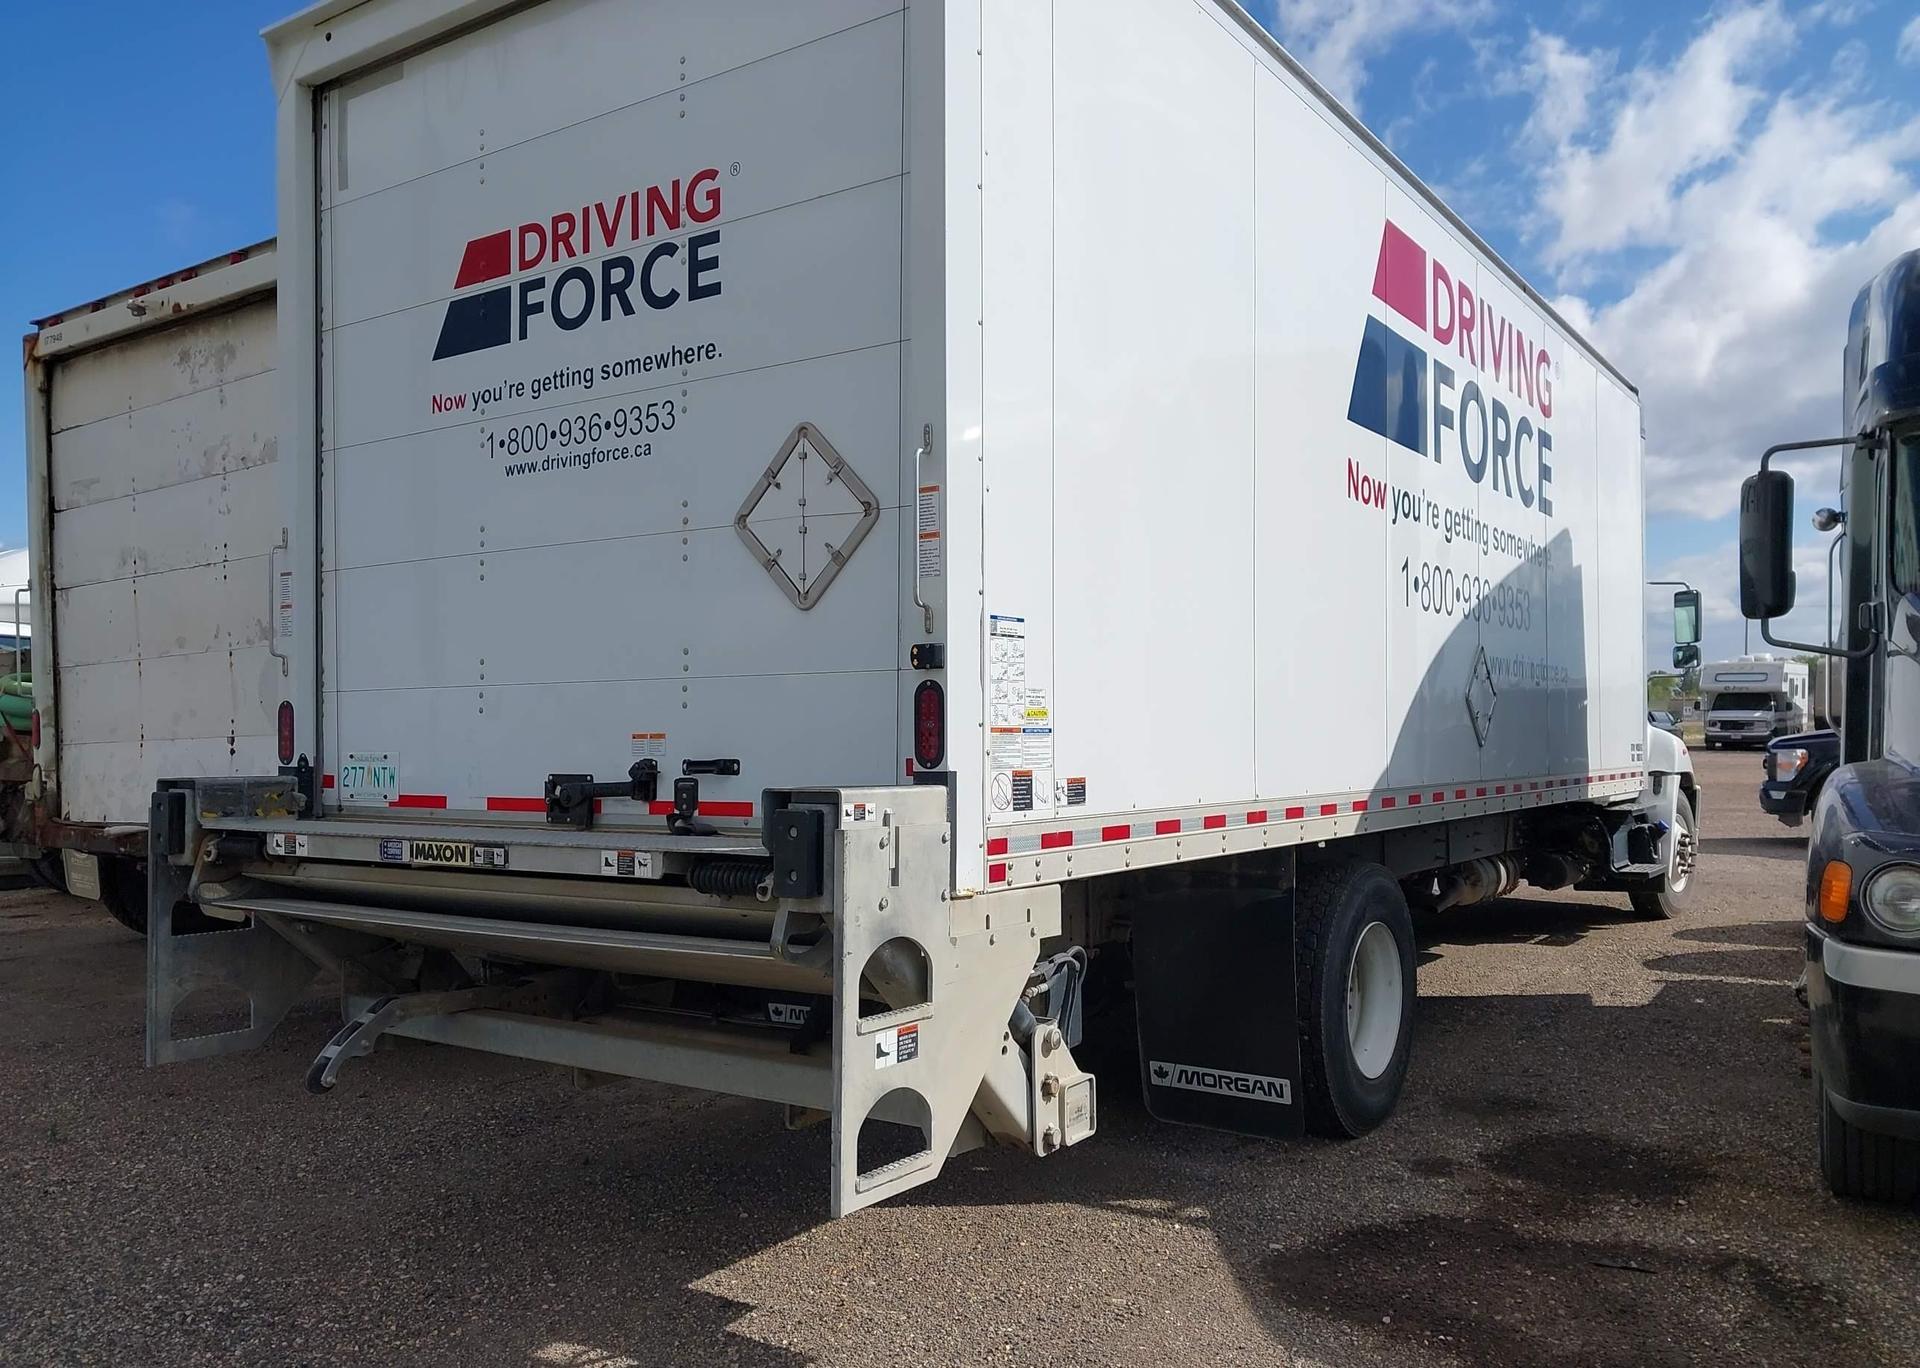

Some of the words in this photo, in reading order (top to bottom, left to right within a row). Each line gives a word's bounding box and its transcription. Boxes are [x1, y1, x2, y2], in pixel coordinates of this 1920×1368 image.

[518, 168, 721, 272] DRIVING
[518, 230, 722, 341] FORCE
[431, 392, 467, 415] Now
[471, 379, 525, 411] you're
[531, 364, 594, 400] getting
[600, 341, 723, 381] somewhere.
[1433, 257, 1552, 419] DRIVING
[504, 440, 652, 478] www.drivingforce.ca
[1433, 358, 1553, 517] FORCE
[1347, 458, 1387, 510] Now
[1391, 488, 1440, 530] you're
[1444, 507, 1488, 556] getting
[342, 766, 365, 788] 277
[373, 766, 396, 789] NTW
[414, 843, 466, 863] MAXON
[1176, 1069, 1285, 1099] MORGAN
